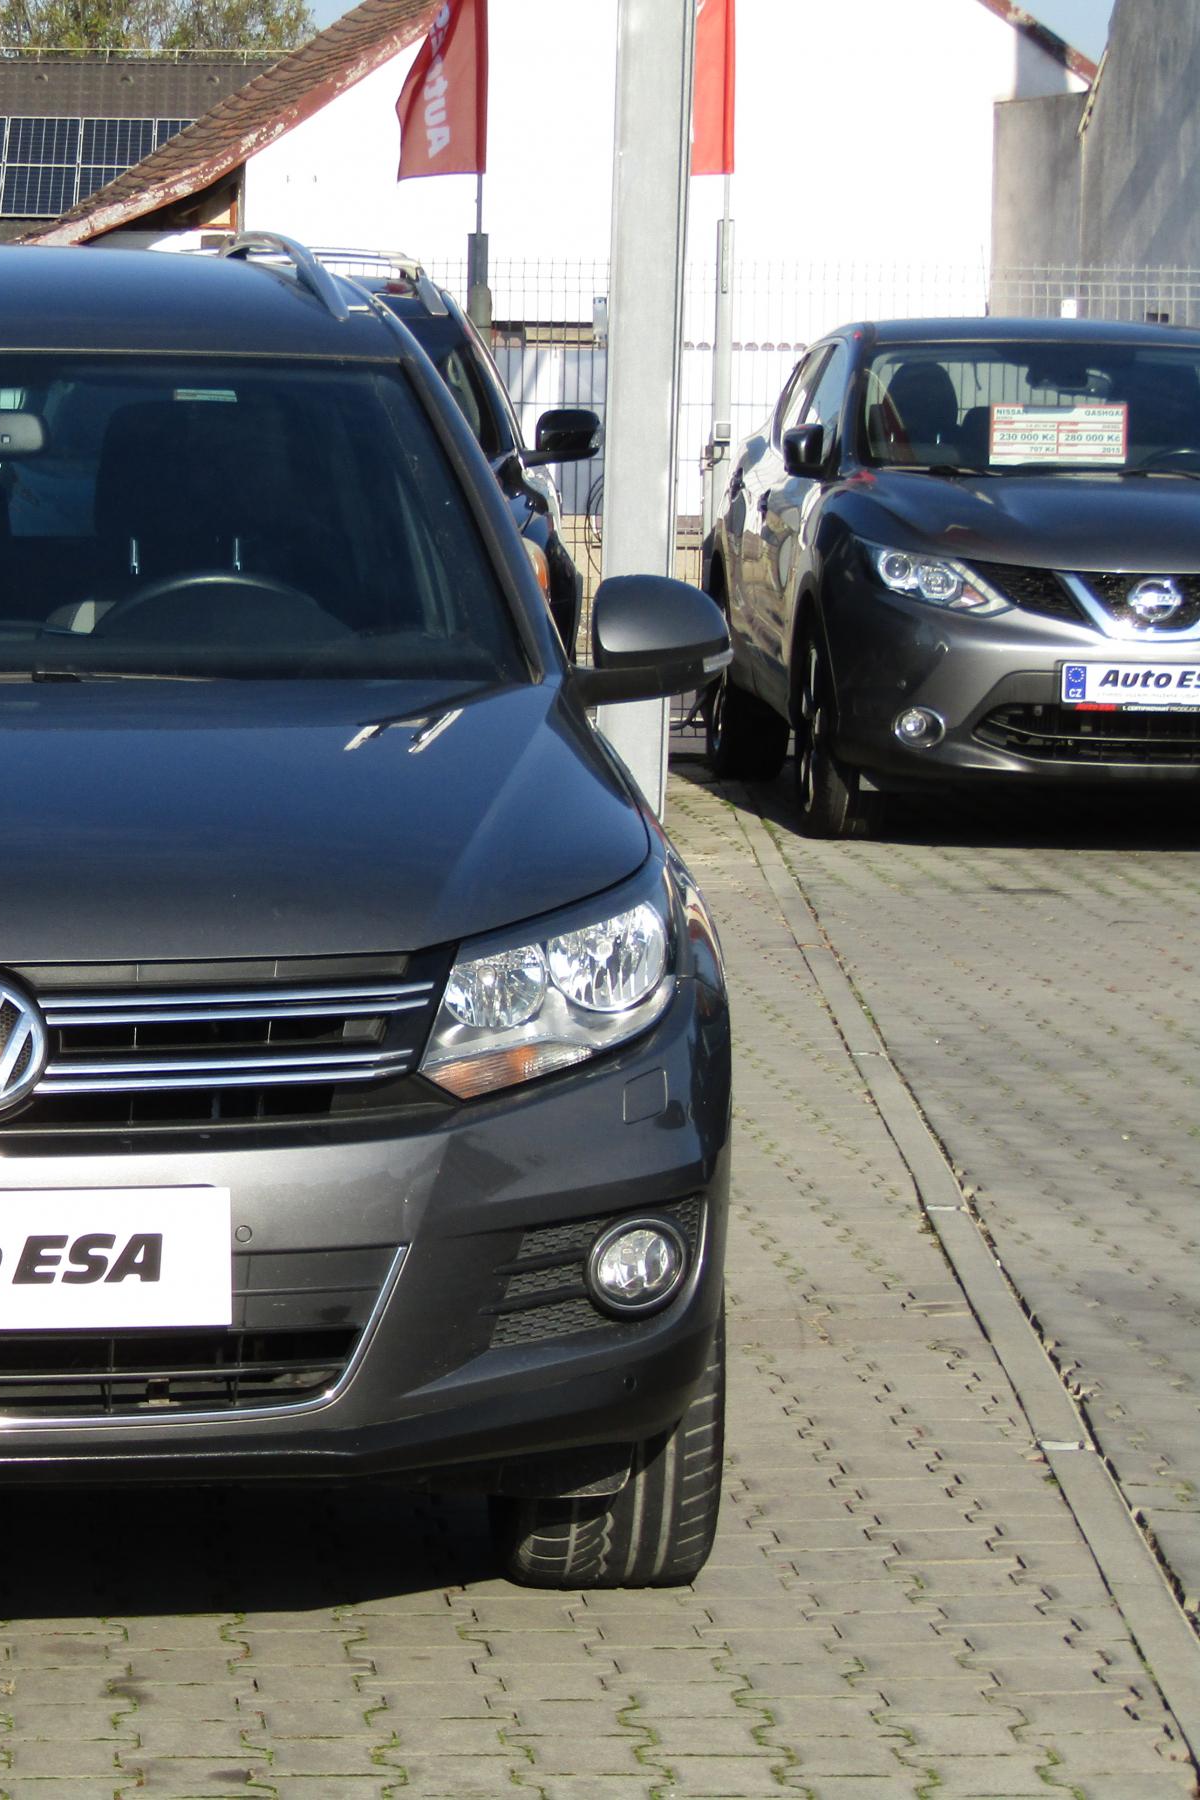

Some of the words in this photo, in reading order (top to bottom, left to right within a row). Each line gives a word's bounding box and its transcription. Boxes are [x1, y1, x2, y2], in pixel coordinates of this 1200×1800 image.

[999, 432, 1018, 441] 230
[1020, 432, 1039, 441] 000
[1064, 433, 1083, 442] 280
[1085, 433, 1104, 442] 000
[1098, 669, 1173, 689] Auto
[1068, 688, 1083, 698] CZ
[12, 1233, 163, 1285] ESA
